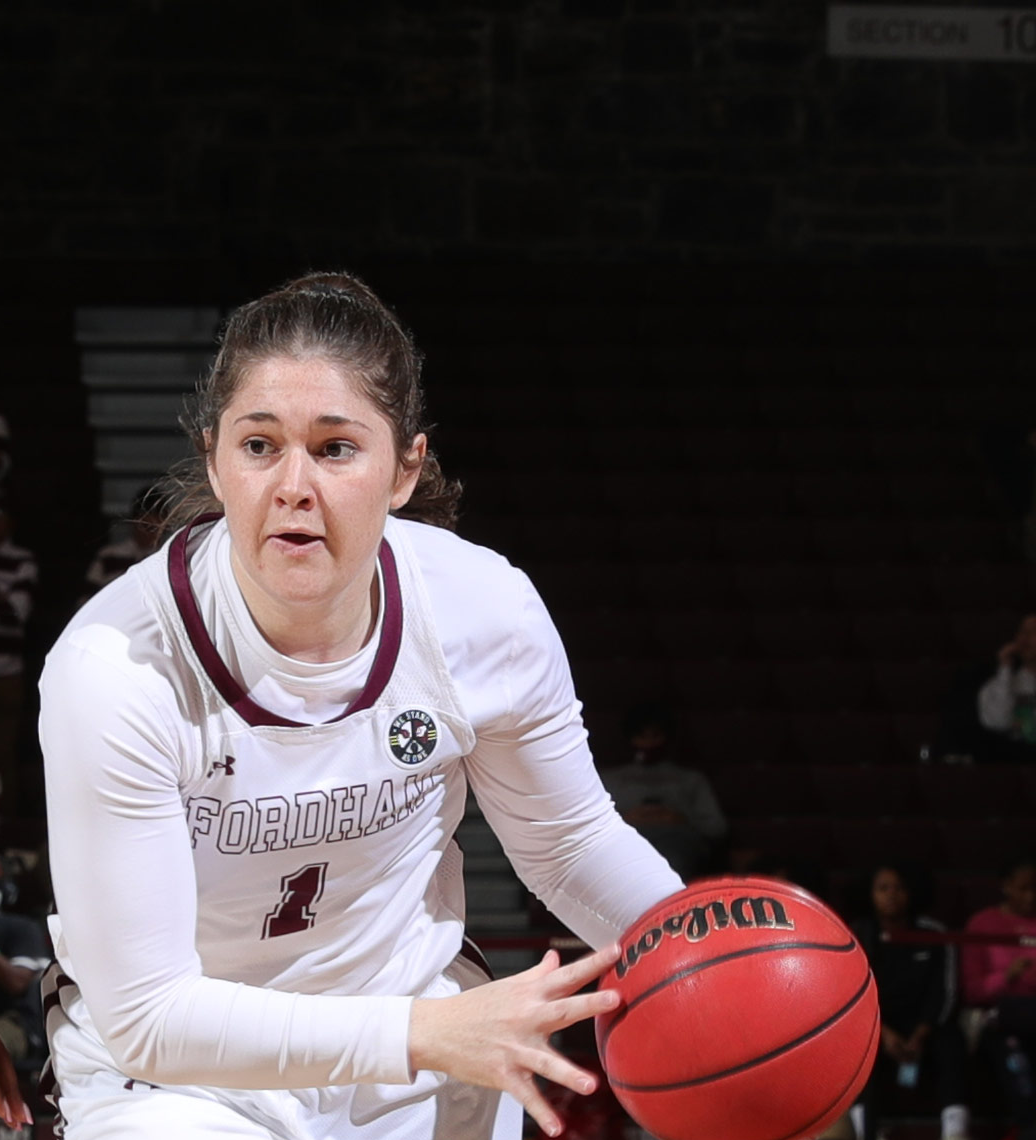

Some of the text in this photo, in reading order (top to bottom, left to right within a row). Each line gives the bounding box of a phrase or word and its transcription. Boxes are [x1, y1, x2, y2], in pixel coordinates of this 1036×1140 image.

[846, 17, 969, 44] SECTION
[406, 711, 430, 724] STAND
[413, 751, 427, 762] ONE
[261, 862, 330, 940] 1
[614, 896, 795, 980] Wilson
